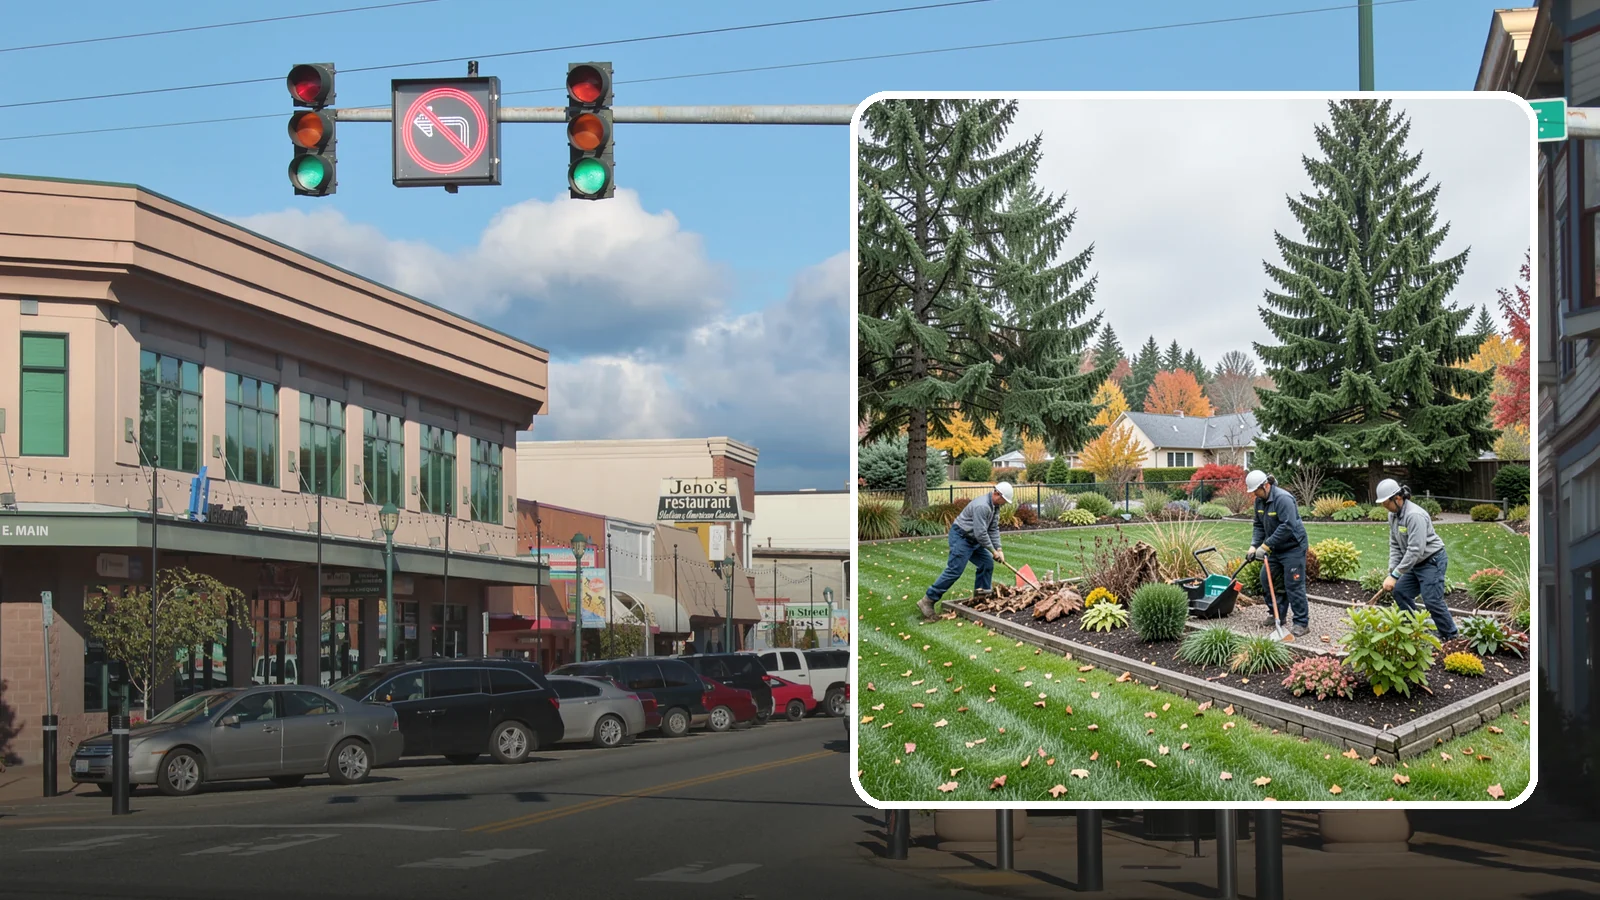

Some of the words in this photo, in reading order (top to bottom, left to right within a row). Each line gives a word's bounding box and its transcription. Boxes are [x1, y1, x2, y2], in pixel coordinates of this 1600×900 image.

[670, 480, 727, 494] Jeno's
[665, 496, 731, 509] restaurant
[686, 509, 714, 519] American
[714, 509, 738, 519] Cuisine
[2, 525, 13, 536] E.
[15, 525, 49, 536] MAIN
[797, 607, 828, 616] Street
